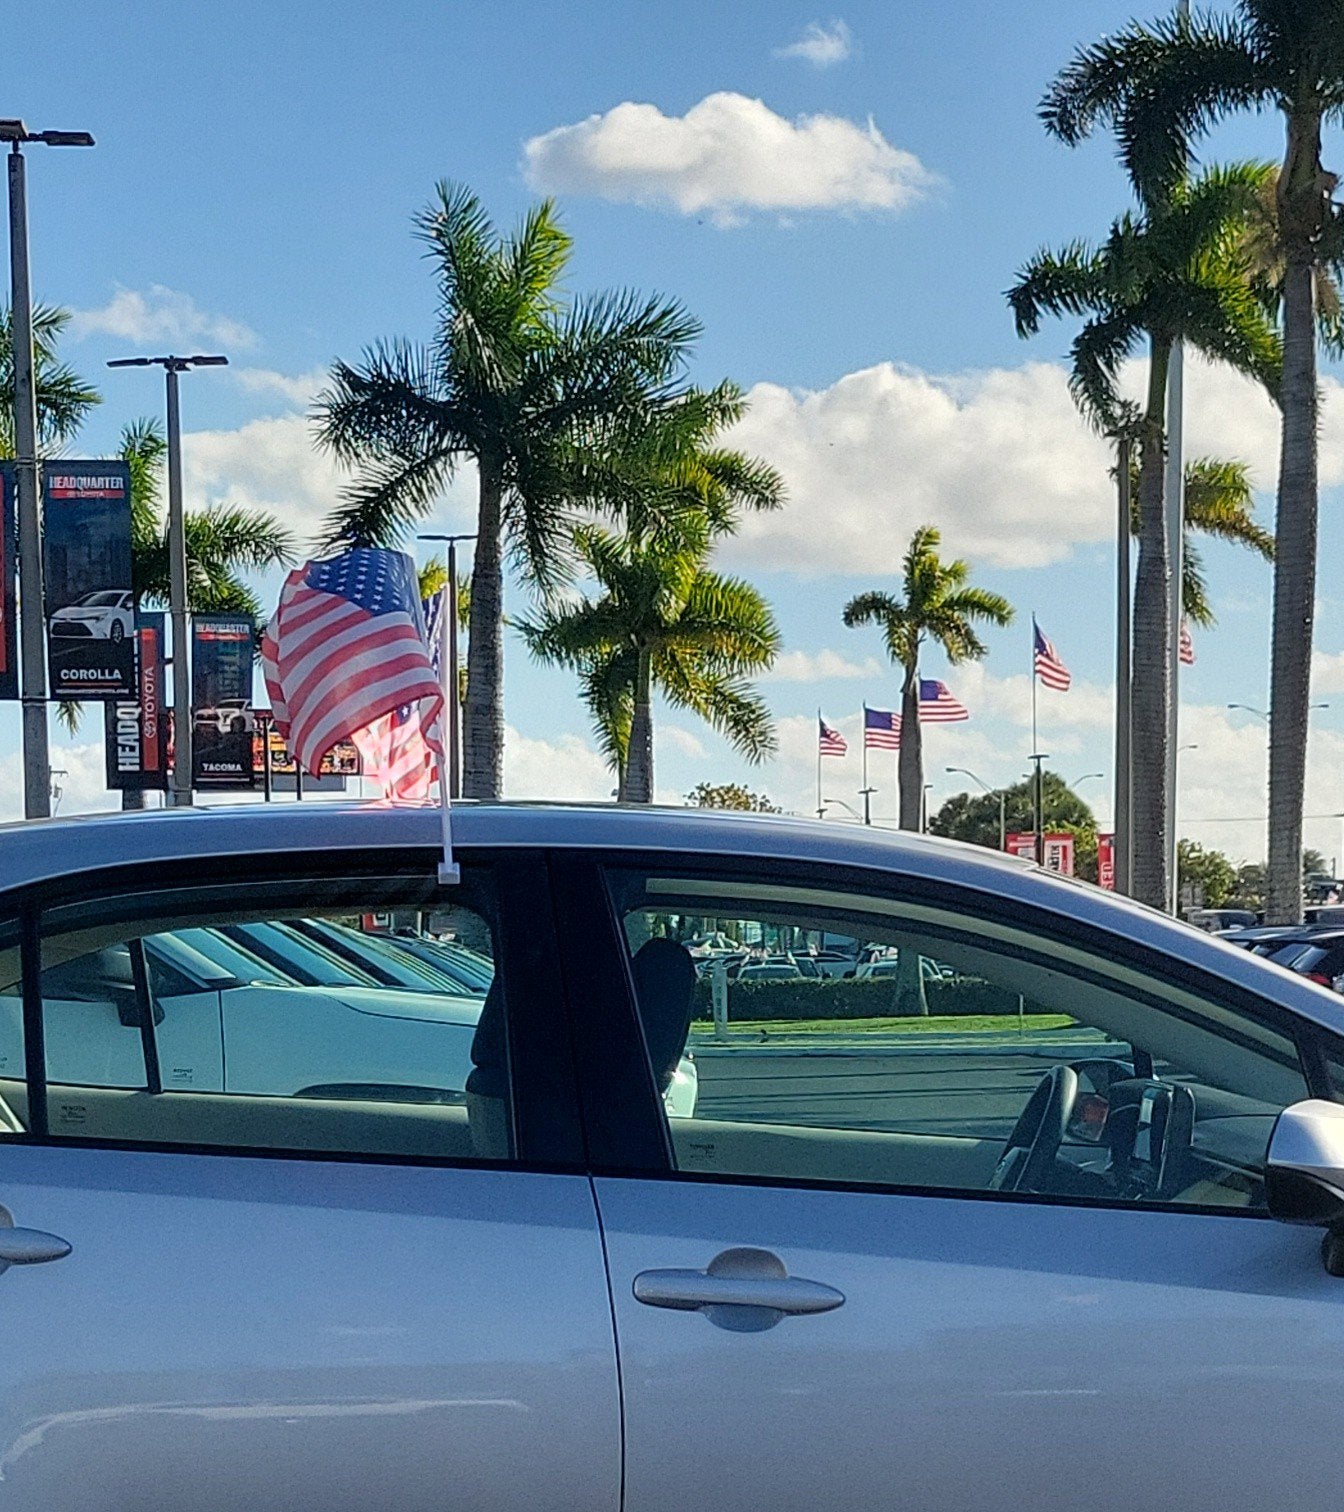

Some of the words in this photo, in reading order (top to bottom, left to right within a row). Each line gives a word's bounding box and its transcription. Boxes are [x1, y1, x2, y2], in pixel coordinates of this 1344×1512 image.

[49, 476, 124, 490] HEADQUARTER
[60, 668, 122, 680] COROLLA
[142, 666, 155, 720] TOYOTA
[202, 763, 243, 772] TACOMA
